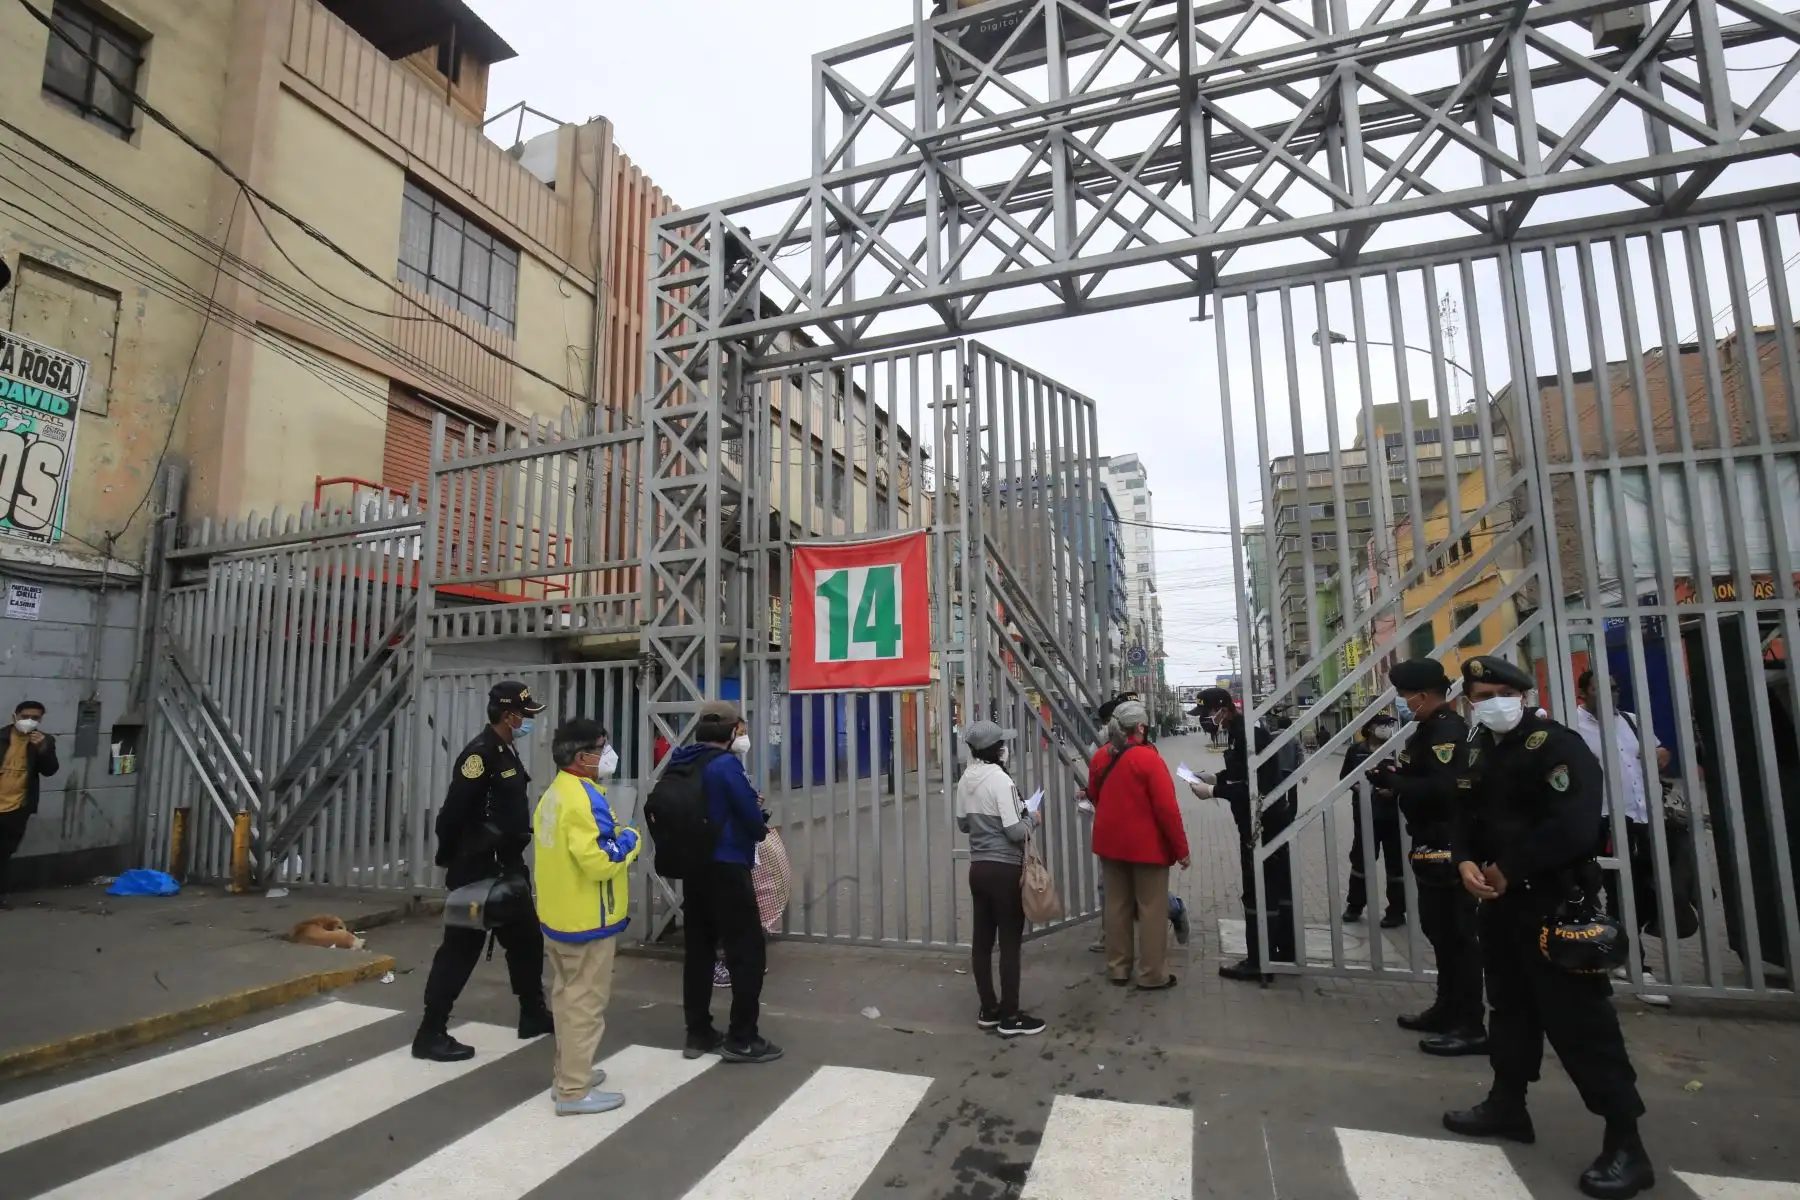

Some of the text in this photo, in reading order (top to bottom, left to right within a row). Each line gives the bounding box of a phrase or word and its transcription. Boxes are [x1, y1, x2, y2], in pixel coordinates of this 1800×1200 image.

[18, 348, 73, 393] ROSA
[16, 590, 37, 599] DRILL
[816, 565, 902, 660] 14
[1555, 924, 1604, 939] POLICIA
